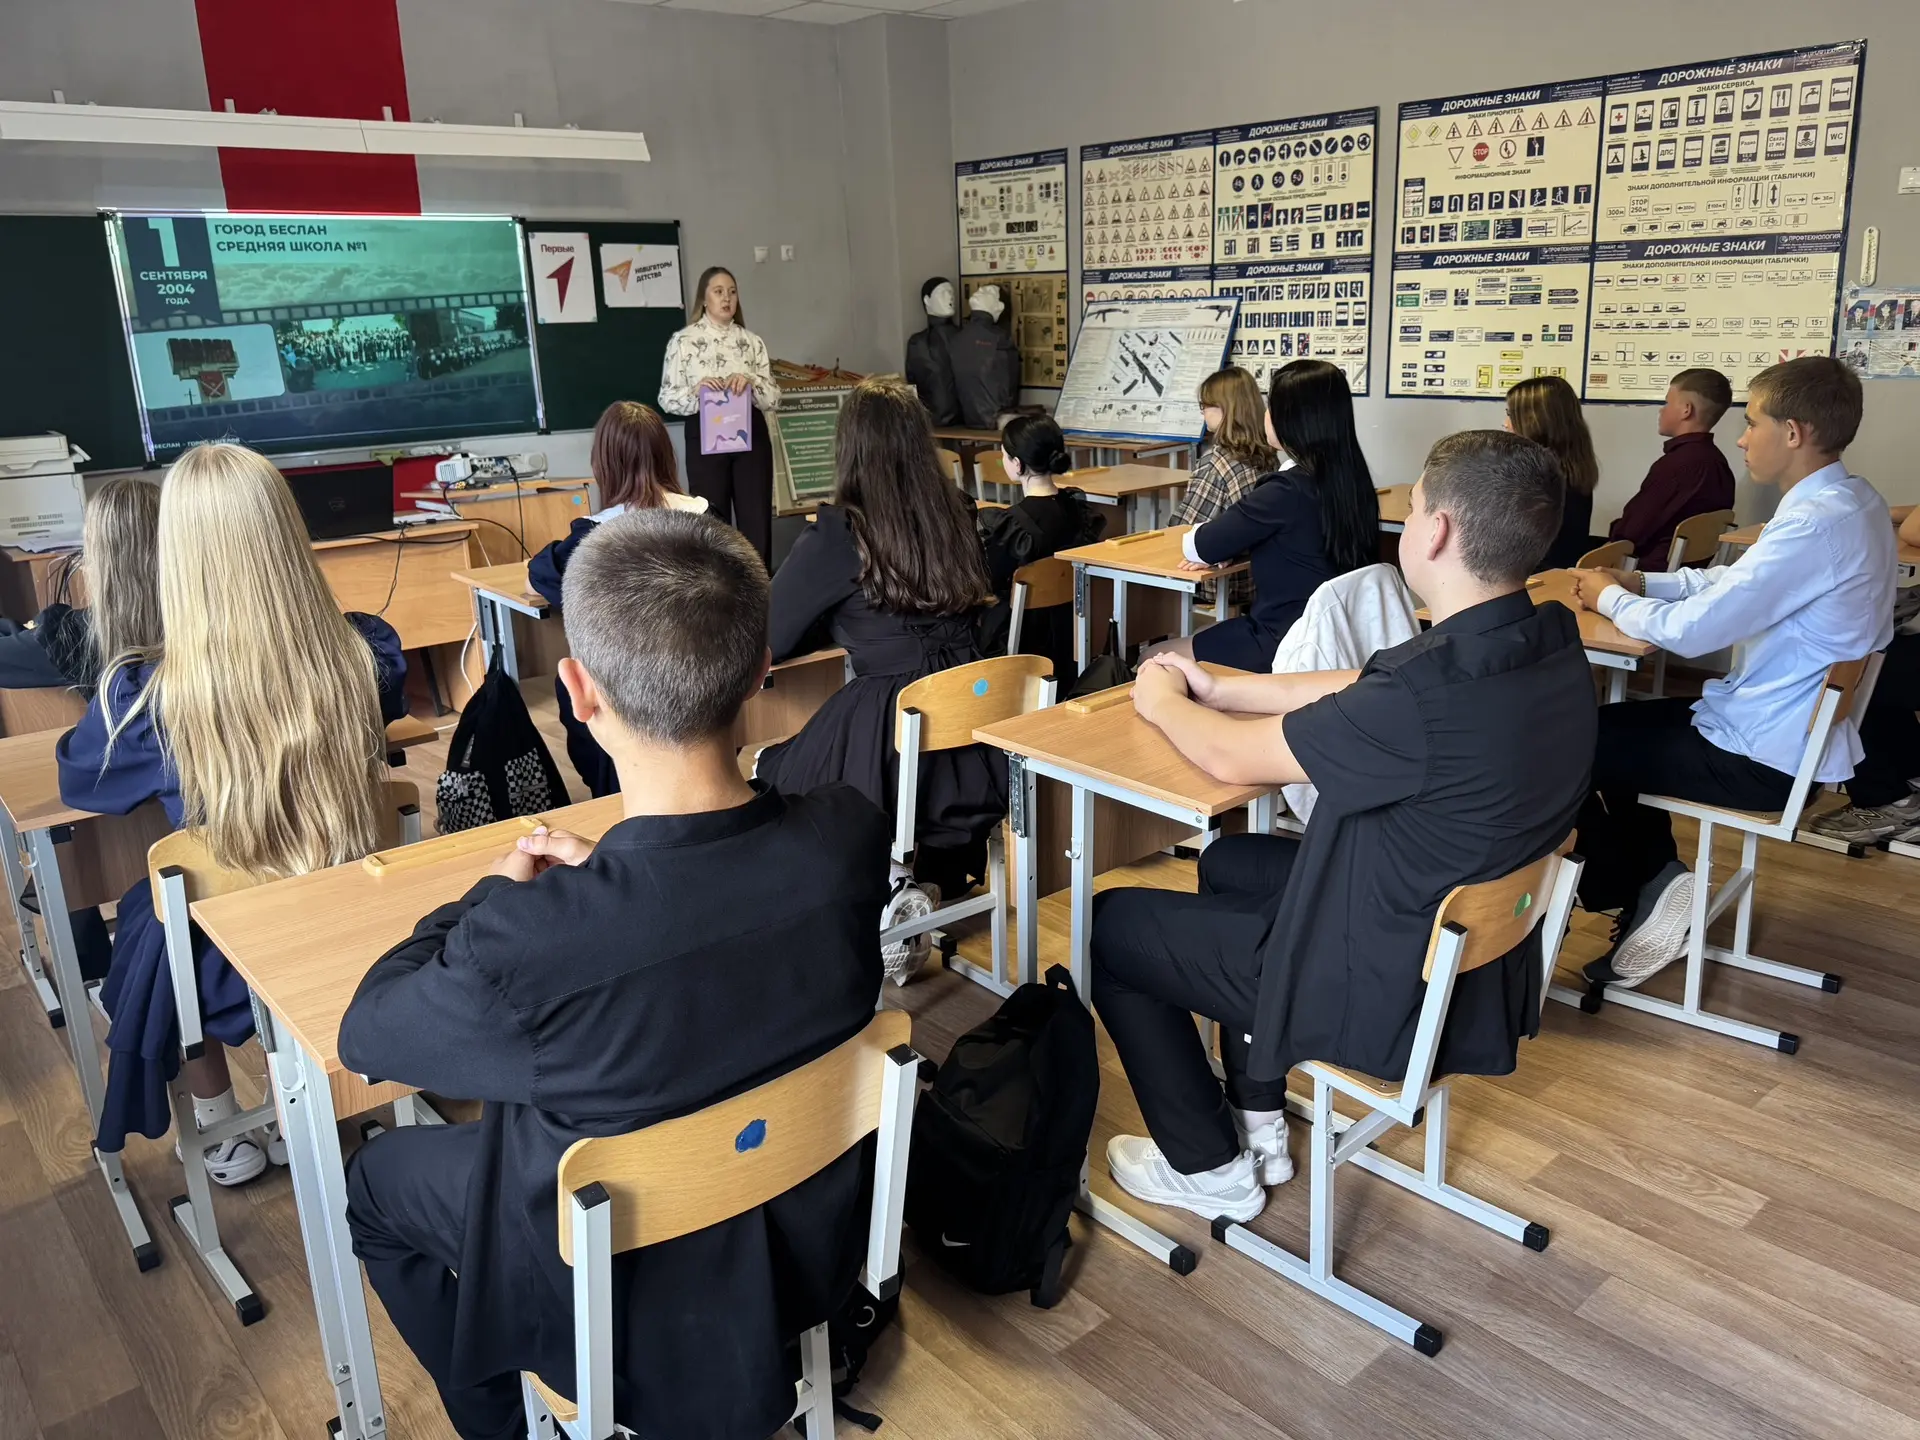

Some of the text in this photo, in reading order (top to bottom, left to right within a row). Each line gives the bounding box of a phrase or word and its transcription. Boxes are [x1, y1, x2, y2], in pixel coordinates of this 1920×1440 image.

[1657, 64, 1735, 86] ДОРОЖНЫЕ
[1737, 58, 1783, 74] ЗНАКИ
[1697, 80, 1755, 93] ЗНАКИ СЕРВИСА
[1441, 94, 1503, 113] ДОРОЖНЫЕ
[1504, 89, 1541, 104] ЗНАКИ
[1467, 108, 1524, 120] ЗНАКИ ПРИОРИТЕТА
[1248, 122, 1299, 138] ДОРОЖНЫЕ
[1299, 118, 1329, 130] ЗНАКИ
[1830, 132, 1843, 140] WC
[1108, 142, 1149, 156] ДОРОЖНЫЕ
[1149, 138, 1174, 149] ЗНАКИ
[1473, 148, 1488, 156] STOP
[1273, 175, 1284, 185] 50
[1455, 168, 1532, 180] ИНФОРМАЦИОННЫЕ ЗНАКИ
[1650, 178, 1716, 190] ДОПОЛНИТЕЛЬНОЙ
[1717, 174, 1770, 184] ИНФОРМАЦИИ
[1771, 171, 1816, 181] (ТАБЛИЧКИ)
[1431, 200, 1442, 209] 50
[214, 224, 327, 237] ГОРОД БЕСЛАН
[148, 217, 180, 268] 1
[216, 241, 368, 253] СРЕДНЯЯ ШКОЛА №1
[1644, 243, 1721, 257] ДОРОЖНЫЕ
[1722, 240, 1766, 252] ЗНАКИ
[540, 244, 575, 255] Первые
[1433, 254, 1494, 266] ДОРОЖНЫЕ
[1495, 252, 1530, 262] ЗНАКИ
[1645, 260, 1711, 269] ДОПОЛНИТЕЛЬНОЙ
[1711, 258, 1764, 266] ИНФОРМАЦИИ
[1765, 256, 1809, 265] (ТАБЛИЧКИ)
[635, 261, 673, 274] НАВИГАТОРЫ
[1246, 264, 1296, 276] ДОРОЖНЫЕ
[1296, 262, 1324, 272] ЗНАКИ
[1449, 268, 1505, 276] ИНФОРМАЦИОННЫЕ
[140, 270, 208, 281] СЕНТЯБРЯ
[636, 271, 662, 283] ДЕТСТВА
[1108, 272, 1148, 281] ДОРОЖНЫЕ
[1148, 270, 1172, 279] ЗНАКИ
[156, 283, 195, 295] 2004
[165, 297, 190, 305] ГОДА
